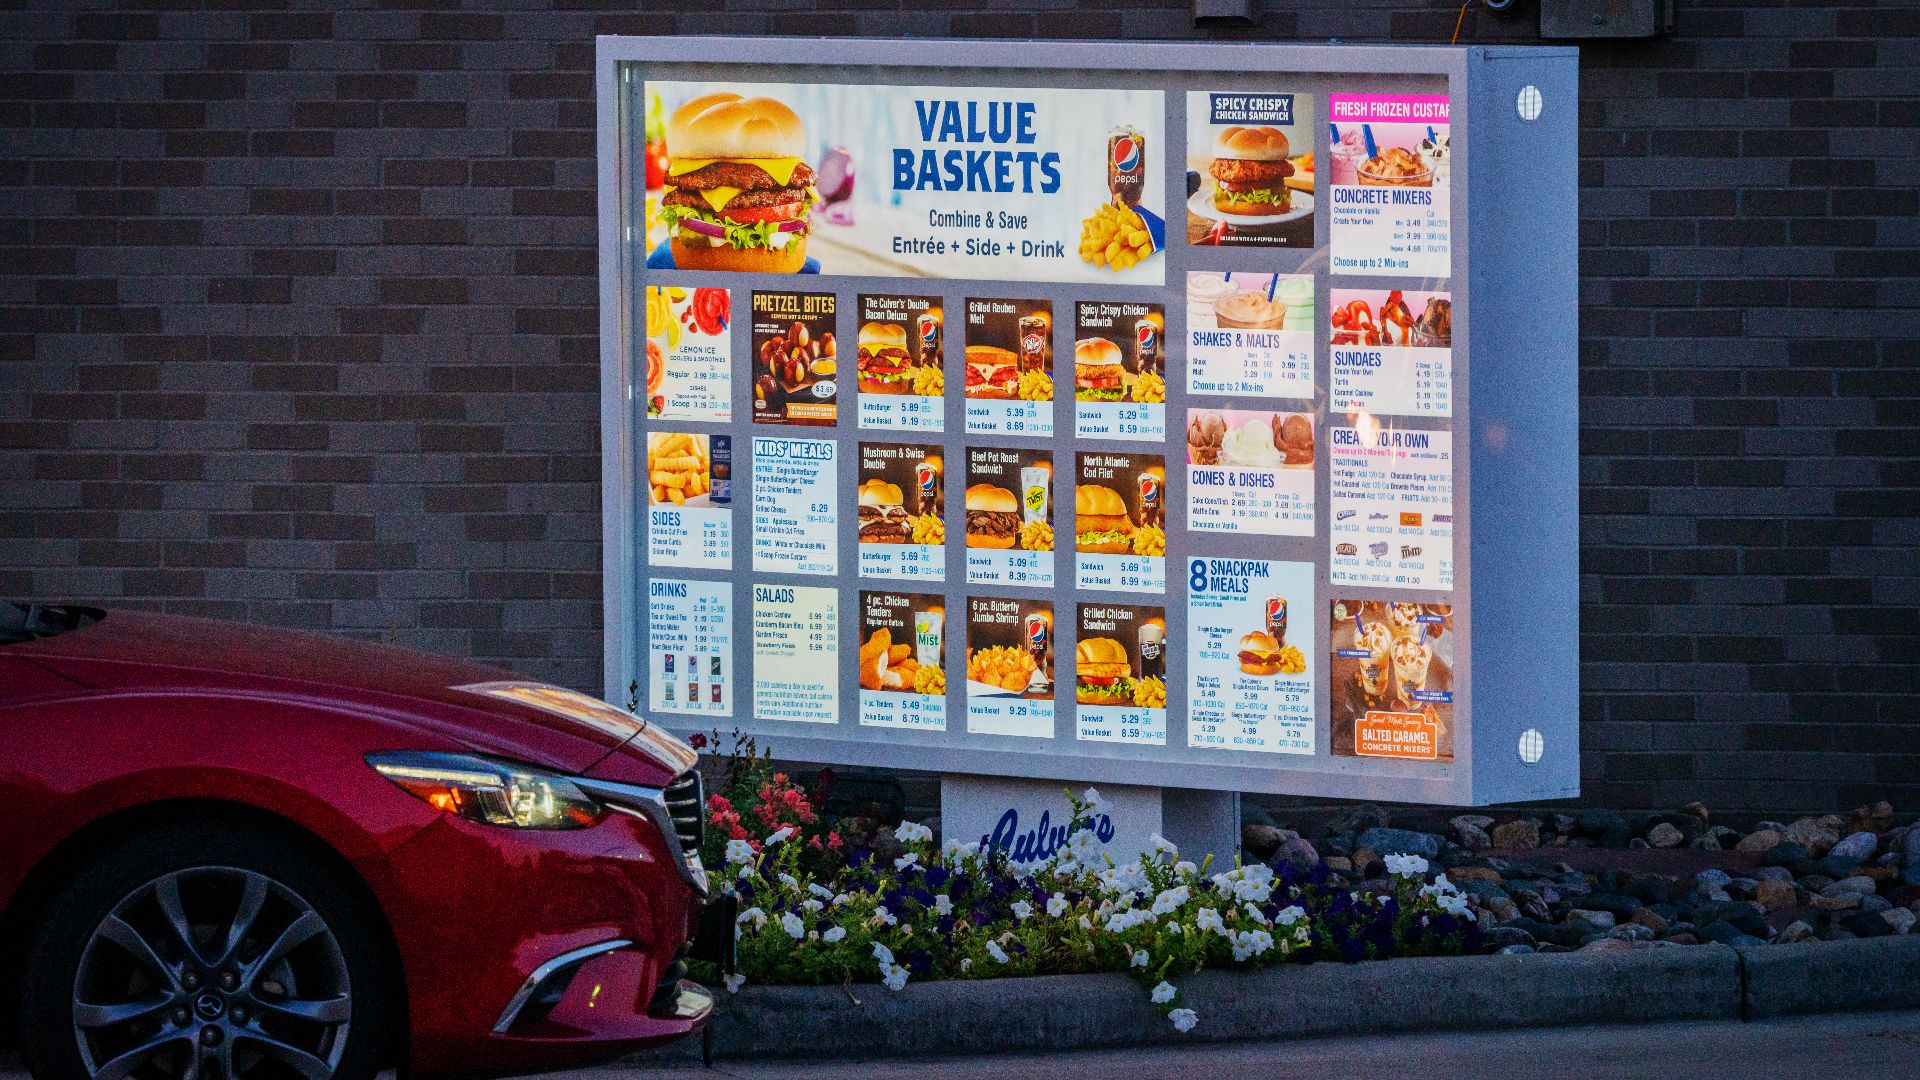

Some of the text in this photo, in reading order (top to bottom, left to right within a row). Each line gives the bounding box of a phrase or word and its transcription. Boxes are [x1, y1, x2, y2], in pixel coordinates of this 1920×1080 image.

[1216, 98, 1289, 111] SPICY CRISPY
[1334, 102, 1367, 116] FRESH
[1371, 102, 1410, 117] FROZEN
[1216, 111, 1288, 121] CHICKEN SANDWICH
[915, 101, 1036, 144] VALUE
[893, 149, 1060, 193] BASKETS
[1115, 174, 1138, 185] pepsi
[1334, 189, 1432, 205] CONCRETE MIXERS
[930, 209, 1027, 229] Combine & Save
[1406, 232, 1420, 240] 3.99
[893, 236, 1064, 257] Entrée + Side + Drink
[1334, 257, 1408, 269] Choose up to 2 Mix-ins
[754, 295, 835, 313] PRETZEL BITES
[865, 297, 930, 310] The Culver's Double
[970, 302, 1015, 313] Grilled Reuben
[865, 309, 907, 320] Bacon Deluxe
[1080, 304, 1148, 317] Spicy Crispy Chicken
[970, 313, 984, 324] Melt
[1080, 317, 1112, 327] Sandwich
[1193, 332, 1280, 348] SHAKES & MALTS
[1335, 351, 1382, 366] SUNDAES
[667, 371, 689, 379] Regular
[1193, 381, 1263, 392] Choose up to 2 Mix-ins
[672, 400, 689, 408] Scoop
[901, 403, 918, 411] 5.89
[1007, 408, 1023, 416] 5.39
[1119, 411, 1136, 419] 5.29
[902, 416, 918, 425] 9.19
[1007, 422, 1023, 430] 8.69
[1119, 424, 1137, 433] 8.59
[1405, 433, 1428, 448] OWN
[755, 440, 832, 460] KIDS' MEALS
[864, 447, 924, 458] Mushroom & Swiss
[972, 452, 1019, 463] Beef Pot Roast
[1084, 456, 1129, 468] North Atlantic
[1333, 459, 1368, 467] TRADITIONALS
[864, 459, 885, 469] Double
[972, 463, 1002, 474] Sandwich
[1084, 467, 1113, 478] Cod Filet
[1193, 471, 1274, 488] CONES & DISHES
[811, 504, 828, 512] 6.29
[652, 511, 680, 526] SIDES
[901, 552, 918, 560] 5.69
[1009, 558, 1026, 566] 5.09
[1121, 563, 1138, 571] 5.69
[902, 566, 918, 574] 8.99
[1009, 572, 1026, 580] 8.39
[1121, 577, 1139, 585] 8.99
[1190, 560, 1269, 592] 8 SNACKPAK
[651, 583, 687, 597] DRINKS
[1211, 577, 1248, 593] MEALS
[756, 588, 794, 603] SALADS
[867, 595, 909, 607] 4 pc. Chicken
[867, 606, 892, 617] Tenders
[973, 601, 1019, 613] 6 pc. Butterfly
[973, 612, 1019, 626] Jumbo Shrimp
[1084, 608, 1133, 620] Grilled Chicken
[1084, 620, 1115, 631] Sandwich
[919, 634, 938, 646] Mist
[902, 701, 919, 709] 5.49
[1010, 706, 1026, 715] 9.29
[903, 715, 919, 723] 8.79
[1121, 715, 1139, 723] 5.29
[1122, 729, 1139, 737] 8.59
[1362, 729, 1430, 744] SALTED CARAMEL
[1362, 743, 1430, 754] CONCRETE MIXERS
